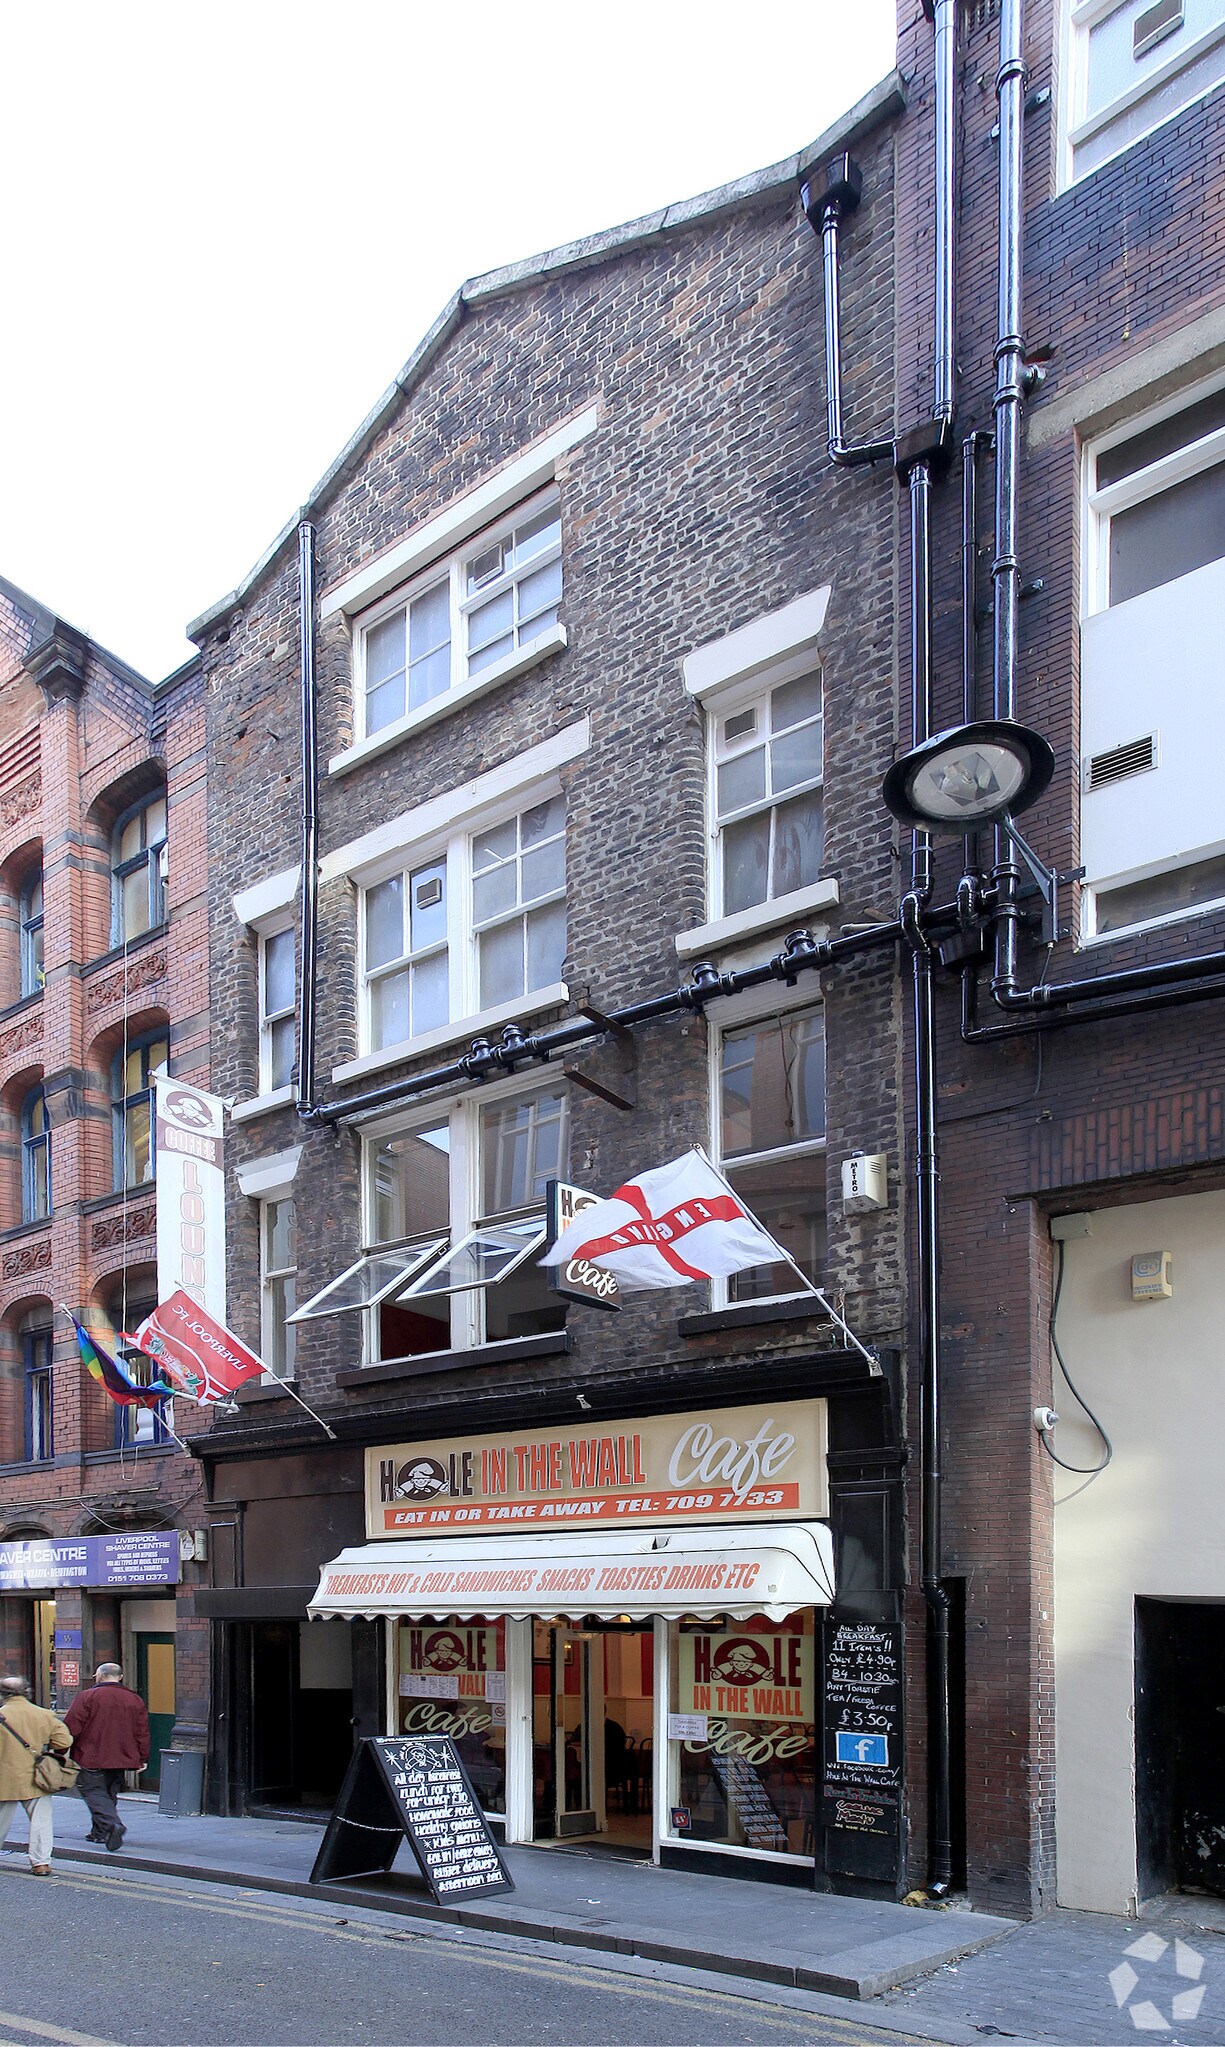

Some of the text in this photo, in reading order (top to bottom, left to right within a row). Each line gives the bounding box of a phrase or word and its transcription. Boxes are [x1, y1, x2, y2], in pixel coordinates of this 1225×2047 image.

[165, 1127, 216, 1161] COFFEE
[850, 1162, 858, 1192] METRO
[180, 1161, 206, 1308] LOUN
[566, 1259, 618, 1297] Cafe
[380, 1418, 797, 1502] HOLE IN THE WALL Cafe
[394, 1490, 784, 1524] EAT IN OR TAKE AWAY TEL: 709 7733
[33, 1546, 87, 1562] CENTRE
[106, 1544, 137, 1552] SHAVER
[116, 1536, 159, 1544] LIVERPOOL
[145, 1573, 168, 1581] 0373
[324, 1562, 761, 1595] BREAKFASTS HOT & COLD SANDWICHES SNACKS TOASTIES DRINKS ETC
[857, 1624, 876, 1632] DAY
[410, 1630, 487, 1671] HOLE
[694, 1636, 802, 1687] HOLE
[693, 1685, 804, 1716] IN THE WALL
[404, 1702, 493, 1740] Cafe
[684, 1720, 810, 1765] Cafe
